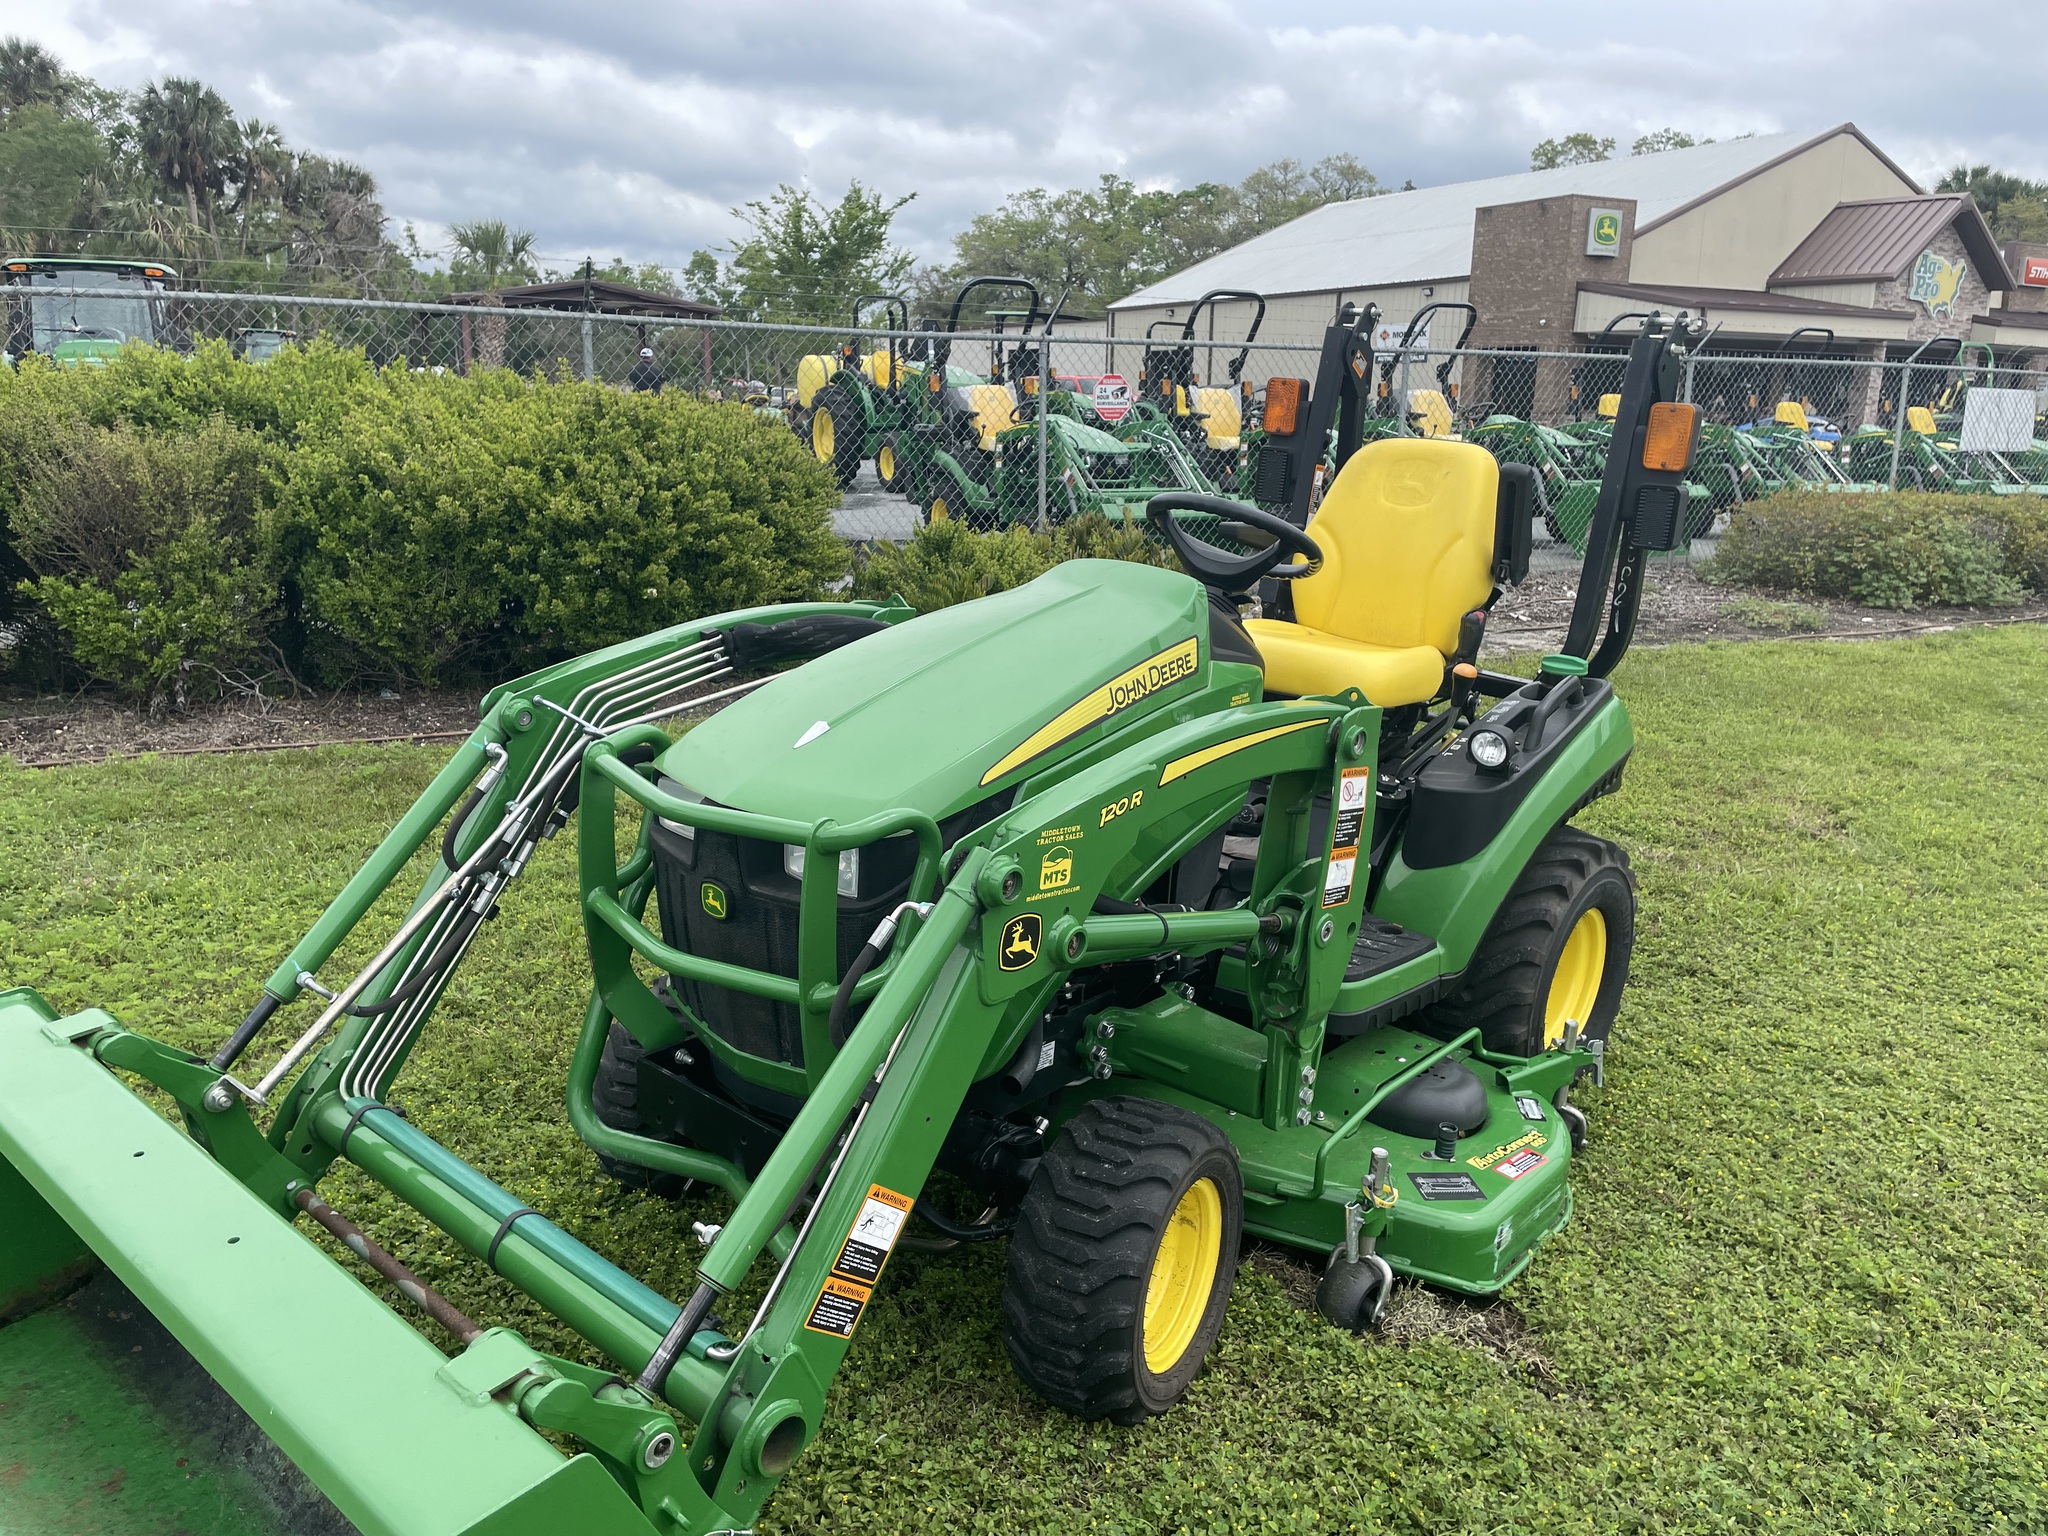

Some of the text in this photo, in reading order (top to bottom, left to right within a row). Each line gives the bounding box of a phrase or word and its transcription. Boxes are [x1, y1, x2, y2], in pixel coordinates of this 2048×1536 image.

[1914, 276, 1939, 297] Pro
[1106, 652, 1193, 713] JOHN DEERE
[1346, 769, 1367, 777] WARNING
[1036, 831, 1084, 846] TRACTOR SALES
[1041, 825, 1081, 837] MIDDLETOWN
[1336, 849, 1356, 860] WARNING
[1043, 869, 1068, 885] MTS
[1026, 885, 1080, 902] middletowntractor.com
[1475, 1129, 1543, 1168] AutoConnect
[880, 1191, 908, 1208] WARNING
[836, 1284, 865, 1299] WARNING
